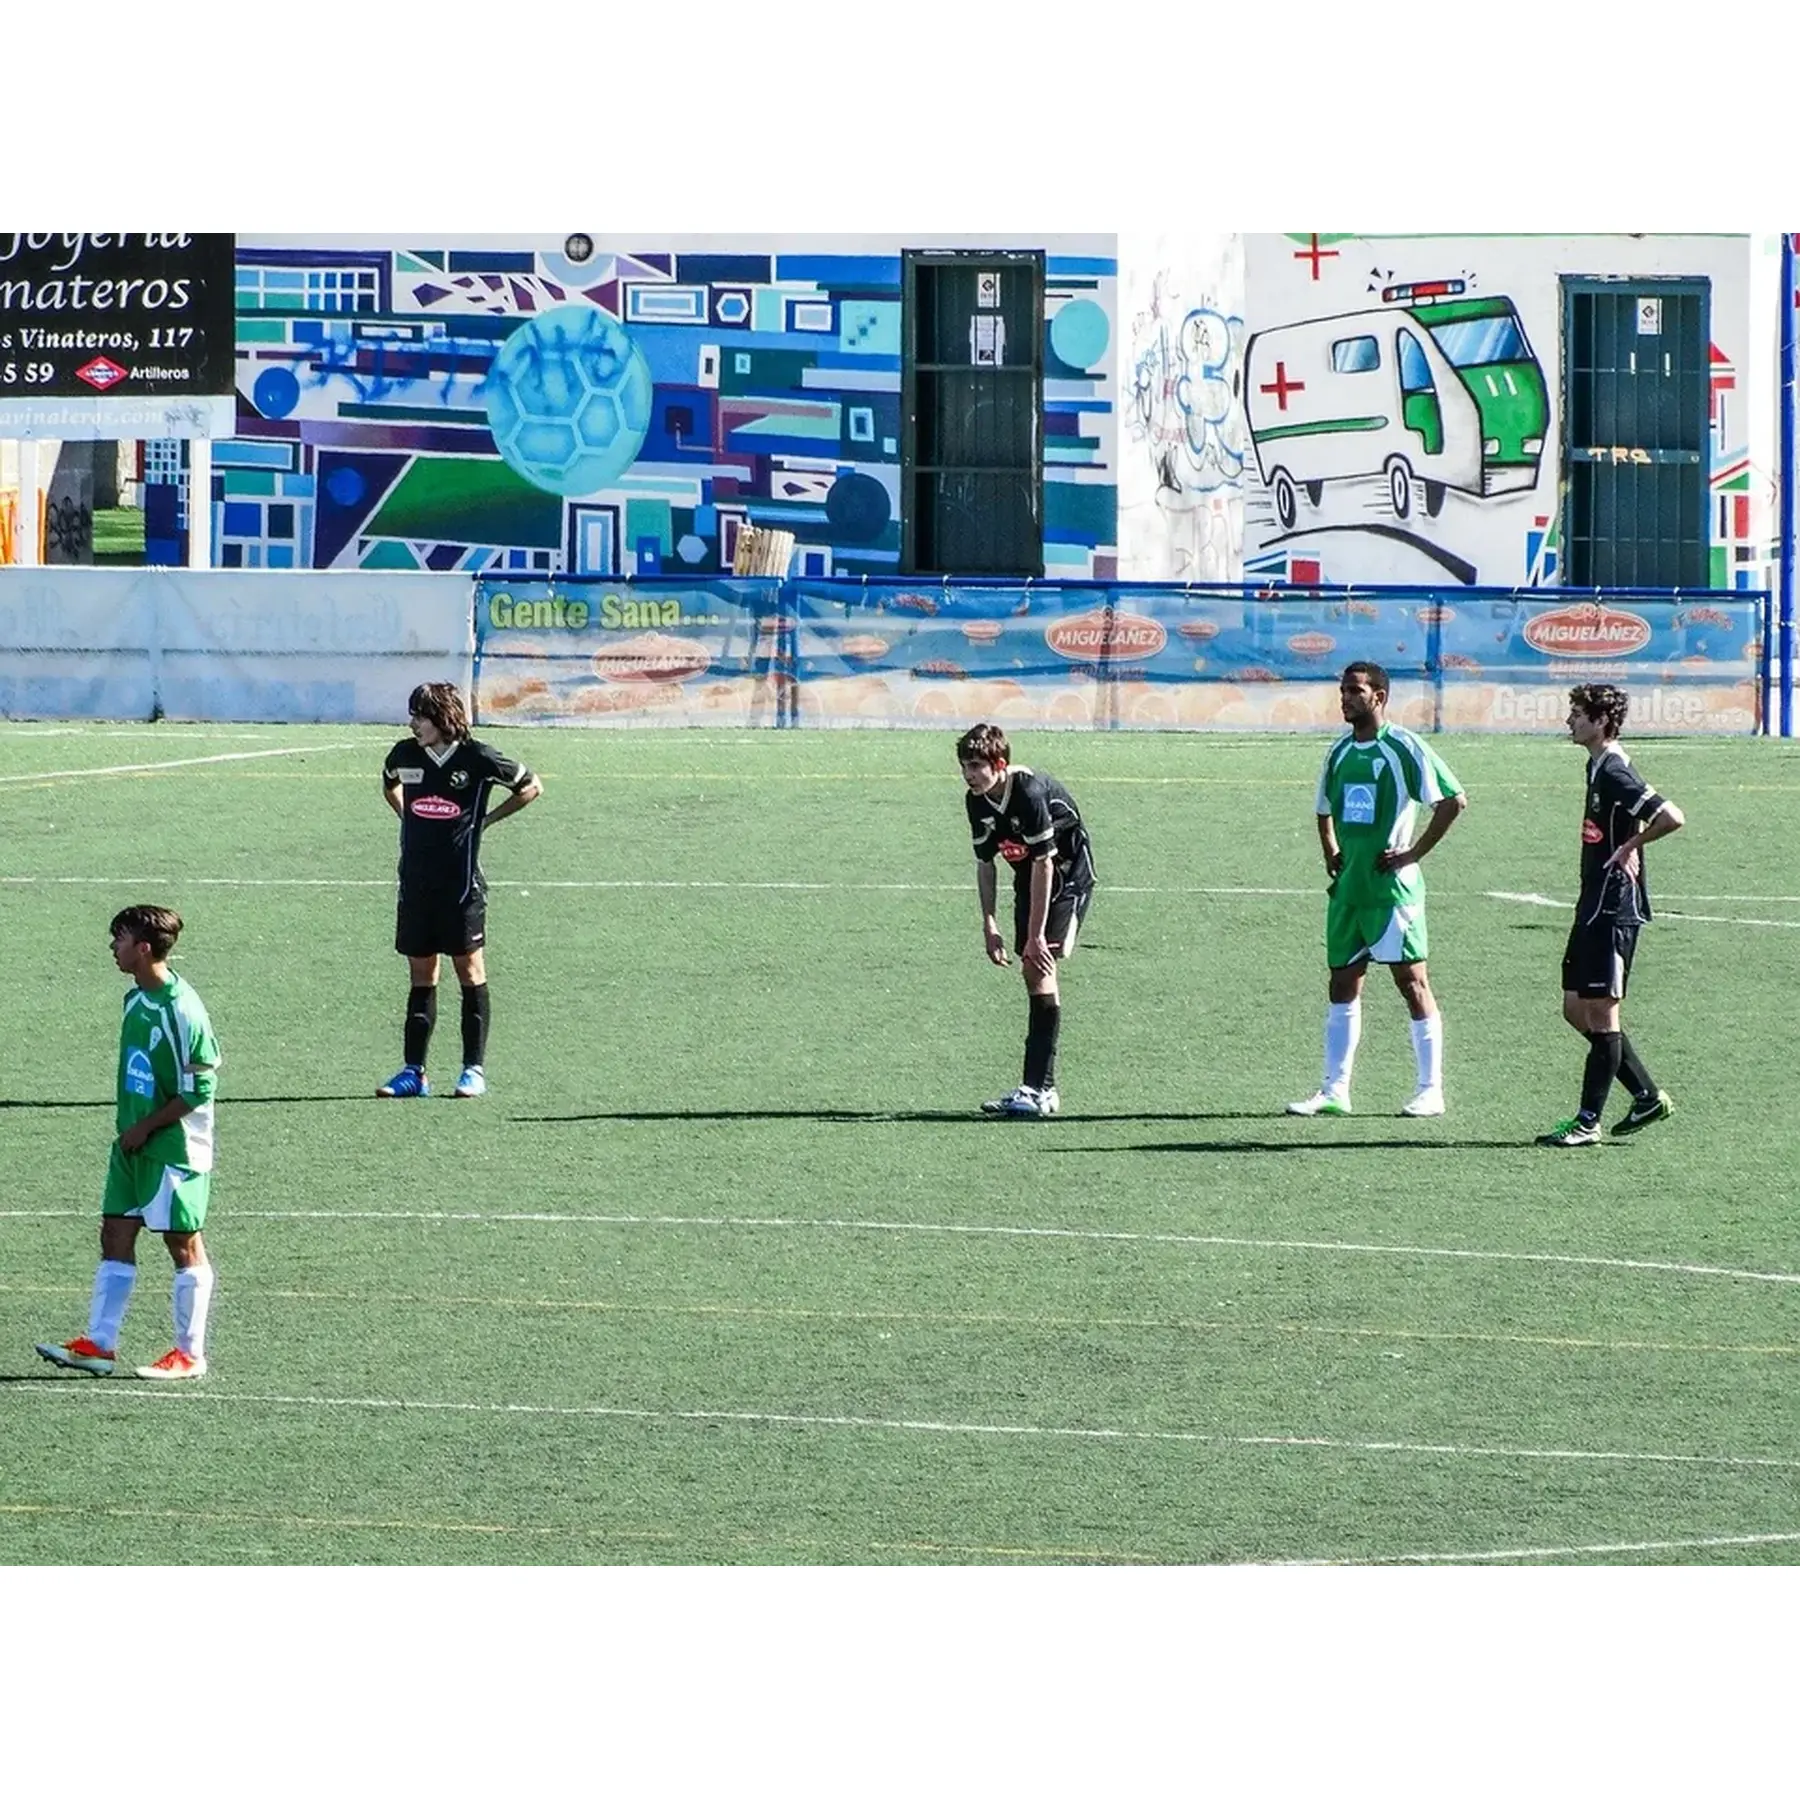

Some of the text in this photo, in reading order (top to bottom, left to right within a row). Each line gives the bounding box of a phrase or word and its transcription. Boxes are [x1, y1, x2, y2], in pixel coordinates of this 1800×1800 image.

[18, 327, 140, 352] Vinateros,
[148, 326, 194, 349] 117
[23, 361, 55, 384] 59
[129, 366, 190, 381] Artilleros
[488, 592, 590, 629] Gente
[1492, 685, 1570, 721] Gen
